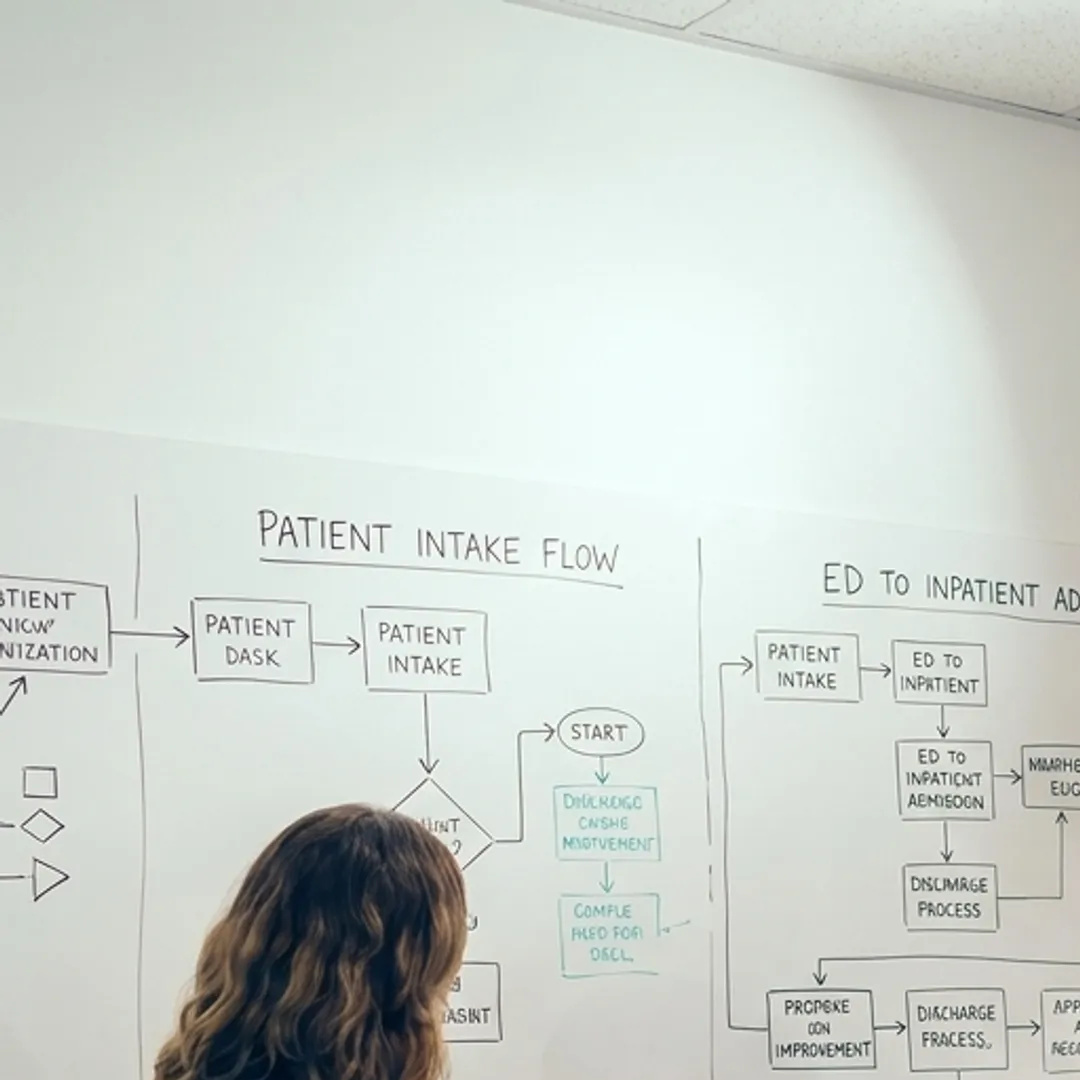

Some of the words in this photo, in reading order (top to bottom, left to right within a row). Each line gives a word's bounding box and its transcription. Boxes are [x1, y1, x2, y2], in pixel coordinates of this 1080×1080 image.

[259, 509, 392, 553] PATIENT
[417, 528, 520, 565] INTAKE
[543, 538, 619, 573] FLOW
[824, 562, 863, 594] ED
[880, 569, 909, 595] TO
[926, 574, 1040, 608] INPATIENT
[205, 613, 296, 638] PATIENT
[379, 621, 466, 645] PATIENT
[226, 645, 281, 668] DASK
[768, 643, 840, 664] PATIENT
[913, 651, 934, 668] ED
[943, 653, 963, 669] TO
[388, 655, 462, 676] INTAKE
[778, 671, 837, 690] INTAKE
[571, 723, 628, 741] START
[918, 748, 940, 765] ED
[947, 750, 966, 765] TO
